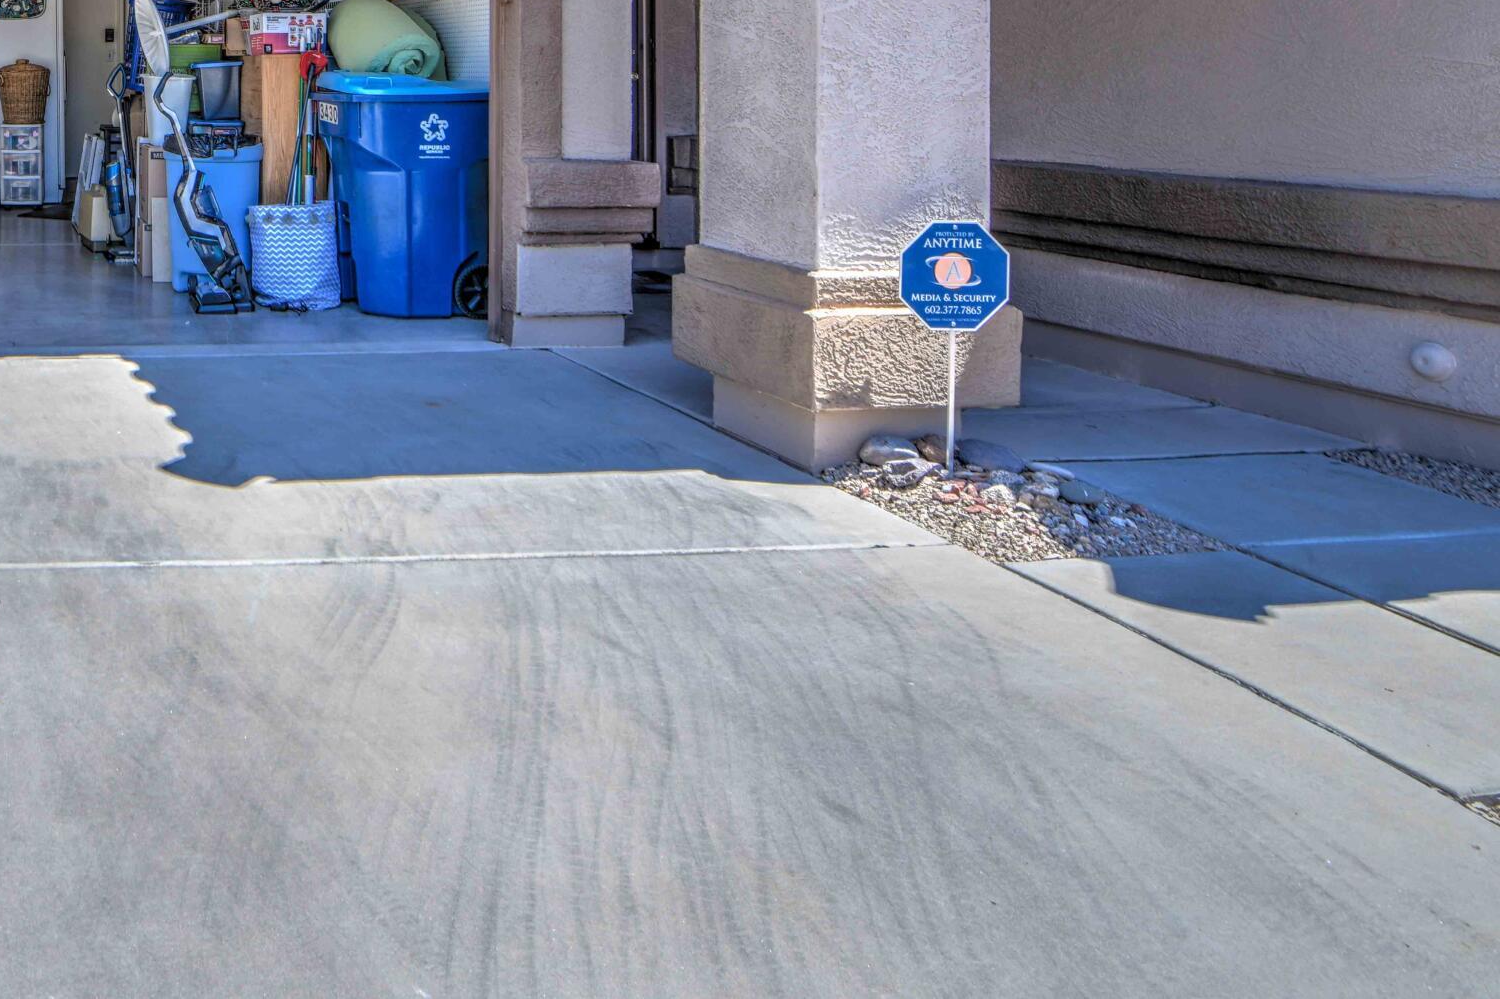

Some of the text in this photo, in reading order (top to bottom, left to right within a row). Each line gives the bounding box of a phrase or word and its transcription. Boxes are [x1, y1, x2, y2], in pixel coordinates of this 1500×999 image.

[320, 103, 337, 122] 3430
[923, 237, 982, 249] ANYTIME
[911, 293, 996, 303] MEDIA & SECURITY
[924, 305, 982, 315] 602.377.7865
